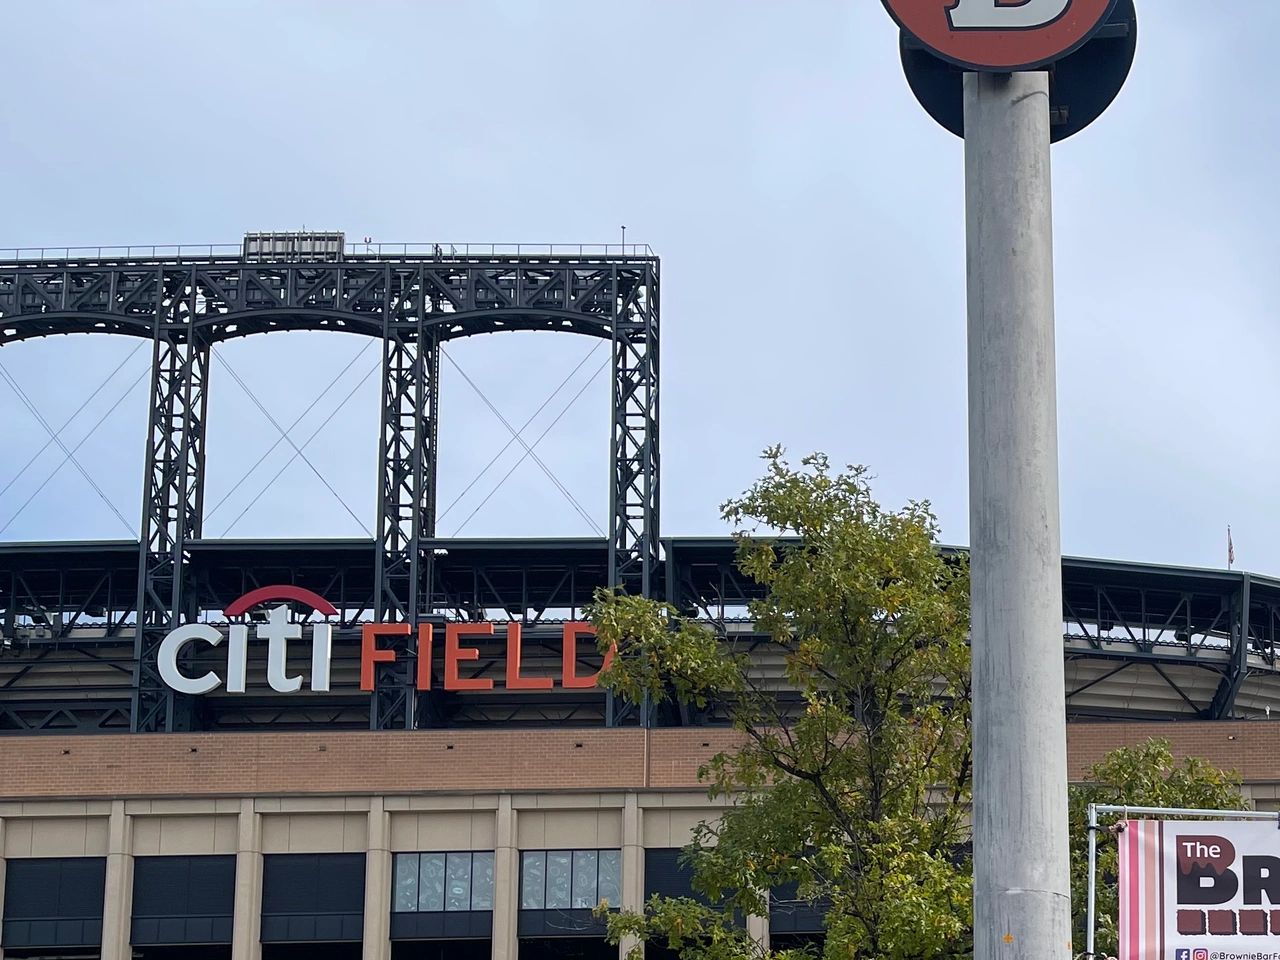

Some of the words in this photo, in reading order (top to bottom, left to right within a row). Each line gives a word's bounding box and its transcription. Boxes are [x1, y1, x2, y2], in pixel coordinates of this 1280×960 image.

[157, 603, 332, 694] citi
[360, 621, 617, 692] FIELD
[1182, 842, 1221, 858] The
